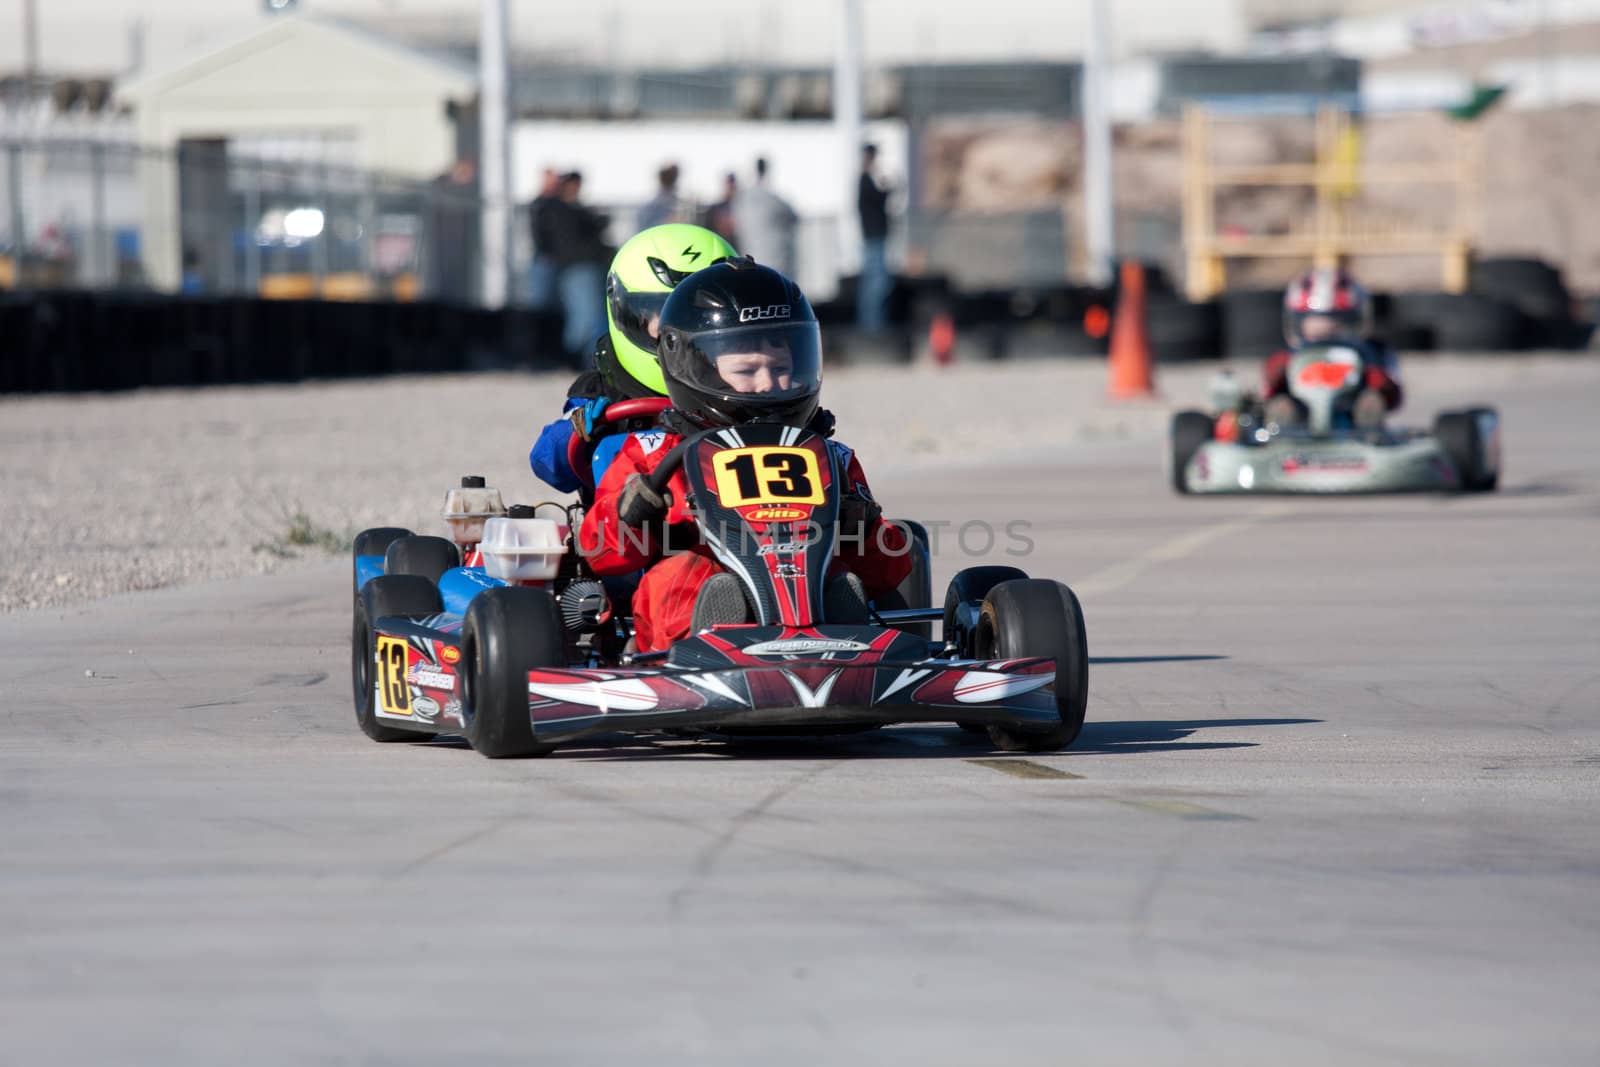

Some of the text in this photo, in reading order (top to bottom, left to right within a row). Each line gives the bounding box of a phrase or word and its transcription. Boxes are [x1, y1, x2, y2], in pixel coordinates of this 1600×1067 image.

[740, 304, 792, 323] HJC
[725, 453, 812, 500] 13
[755, 508, 801, 519] Pitts
[380, 642, 409, 710] 13
